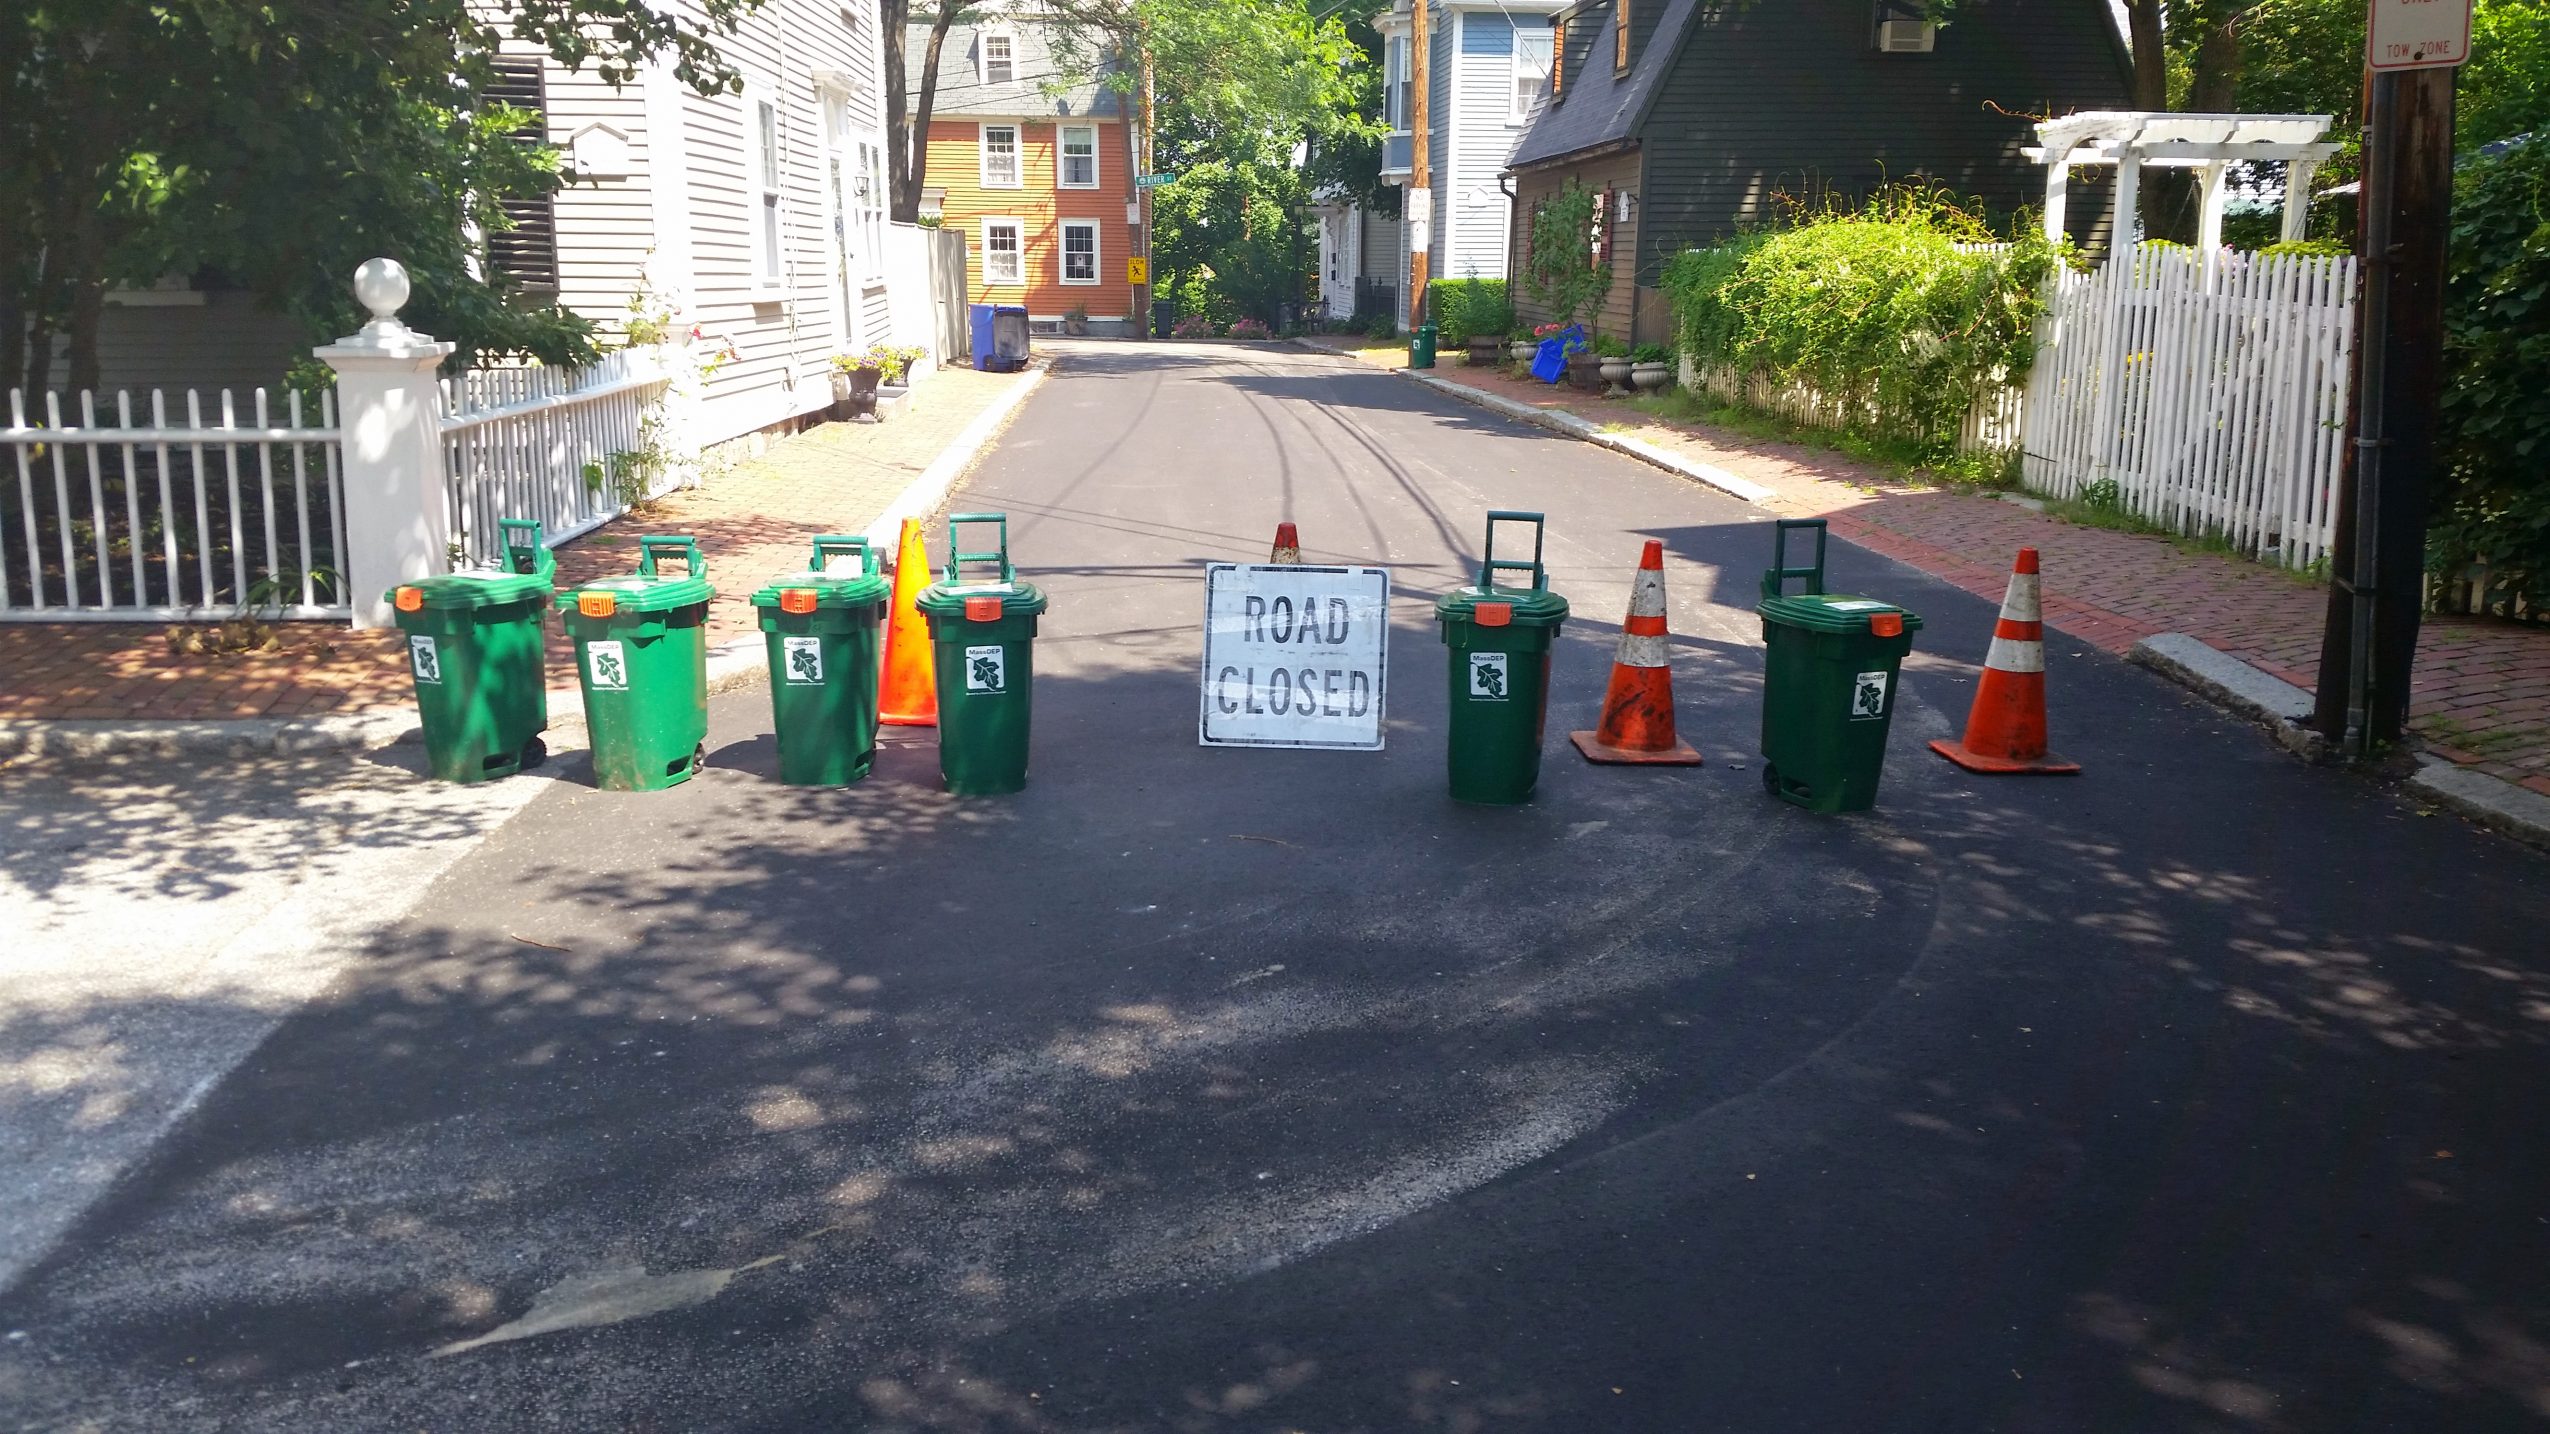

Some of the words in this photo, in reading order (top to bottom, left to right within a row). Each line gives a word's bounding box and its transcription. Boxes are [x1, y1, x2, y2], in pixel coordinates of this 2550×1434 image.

[2386, 44, 2410, 58] TOW
[2420, 40, 2451, 55] ZONE
[1147, 175, 1165, 184] RIVER
[1244, 595, 1349, 644] ROAD
[1218, 666, 1370, 717] CLOSED
